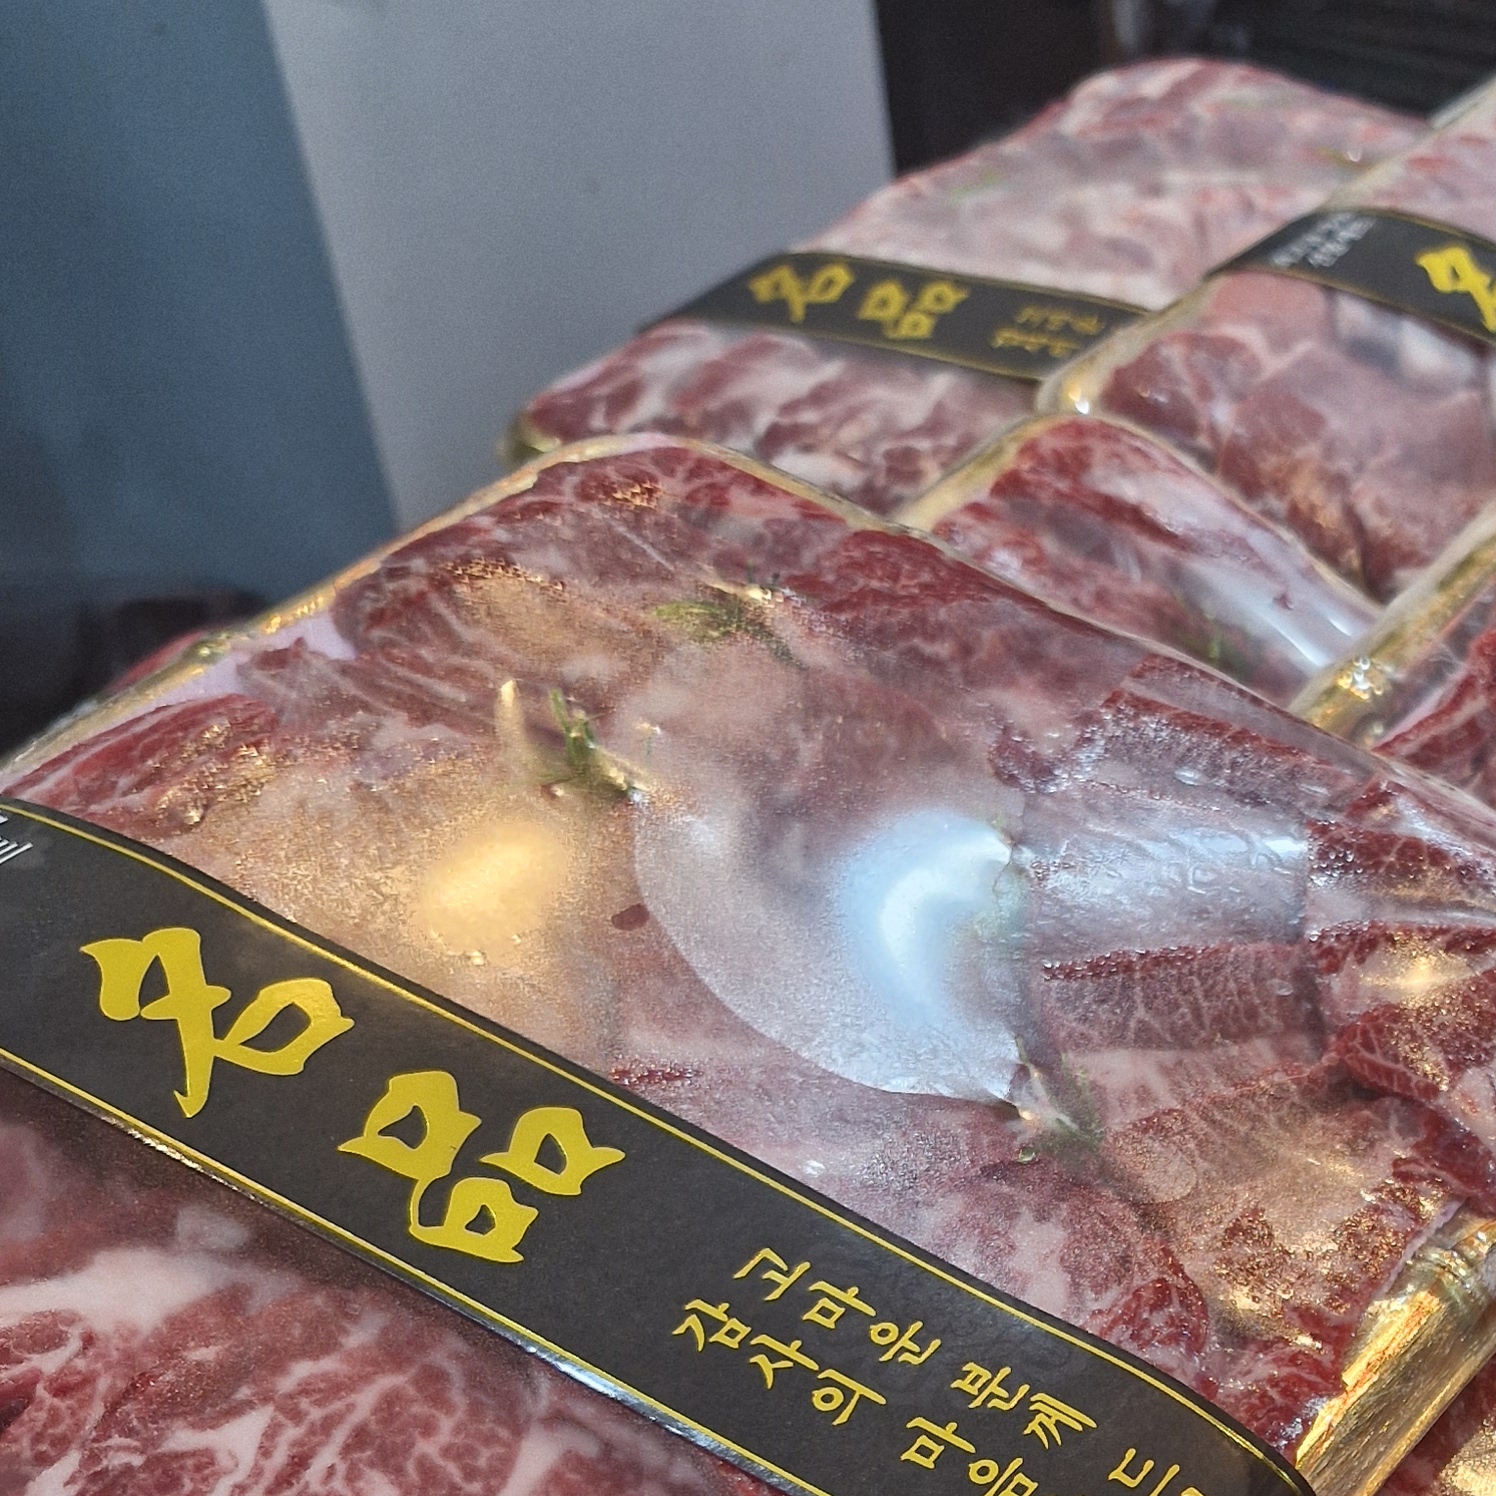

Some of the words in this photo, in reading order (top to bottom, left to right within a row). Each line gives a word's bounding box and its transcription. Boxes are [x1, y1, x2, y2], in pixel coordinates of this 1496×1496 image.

[80, 926, 626, 1263] 名品
[672, 1299, 886, 1426] 감사의
[733, 1247, 943, 1366] 고마운
[951, 1362, 1098, 1449] 분께
